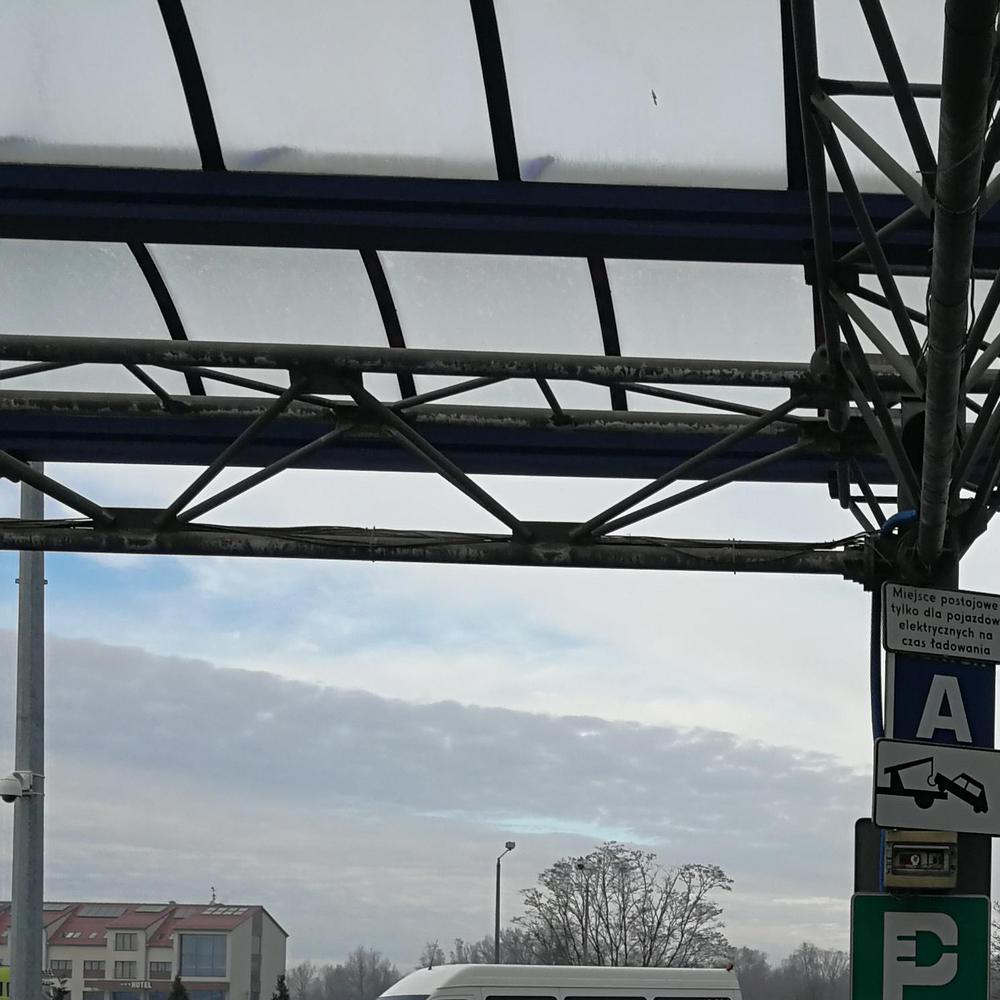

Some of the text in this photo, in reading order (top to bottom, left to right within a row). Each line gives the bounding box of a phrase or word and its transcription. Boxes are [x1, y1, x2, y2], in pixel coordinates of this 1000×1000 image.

[893, 587, 999, 611] Miejsce postojowe
[891, 604, 919, 616] tylko
[923, 607, 942, 619] dla
[899, 620, 993, 640] elektrycznych na
[902, 637, 991, 655] czas ładowania
[915, 674, 973, 744] A
[131, 981, 152, 989] HOTEL
